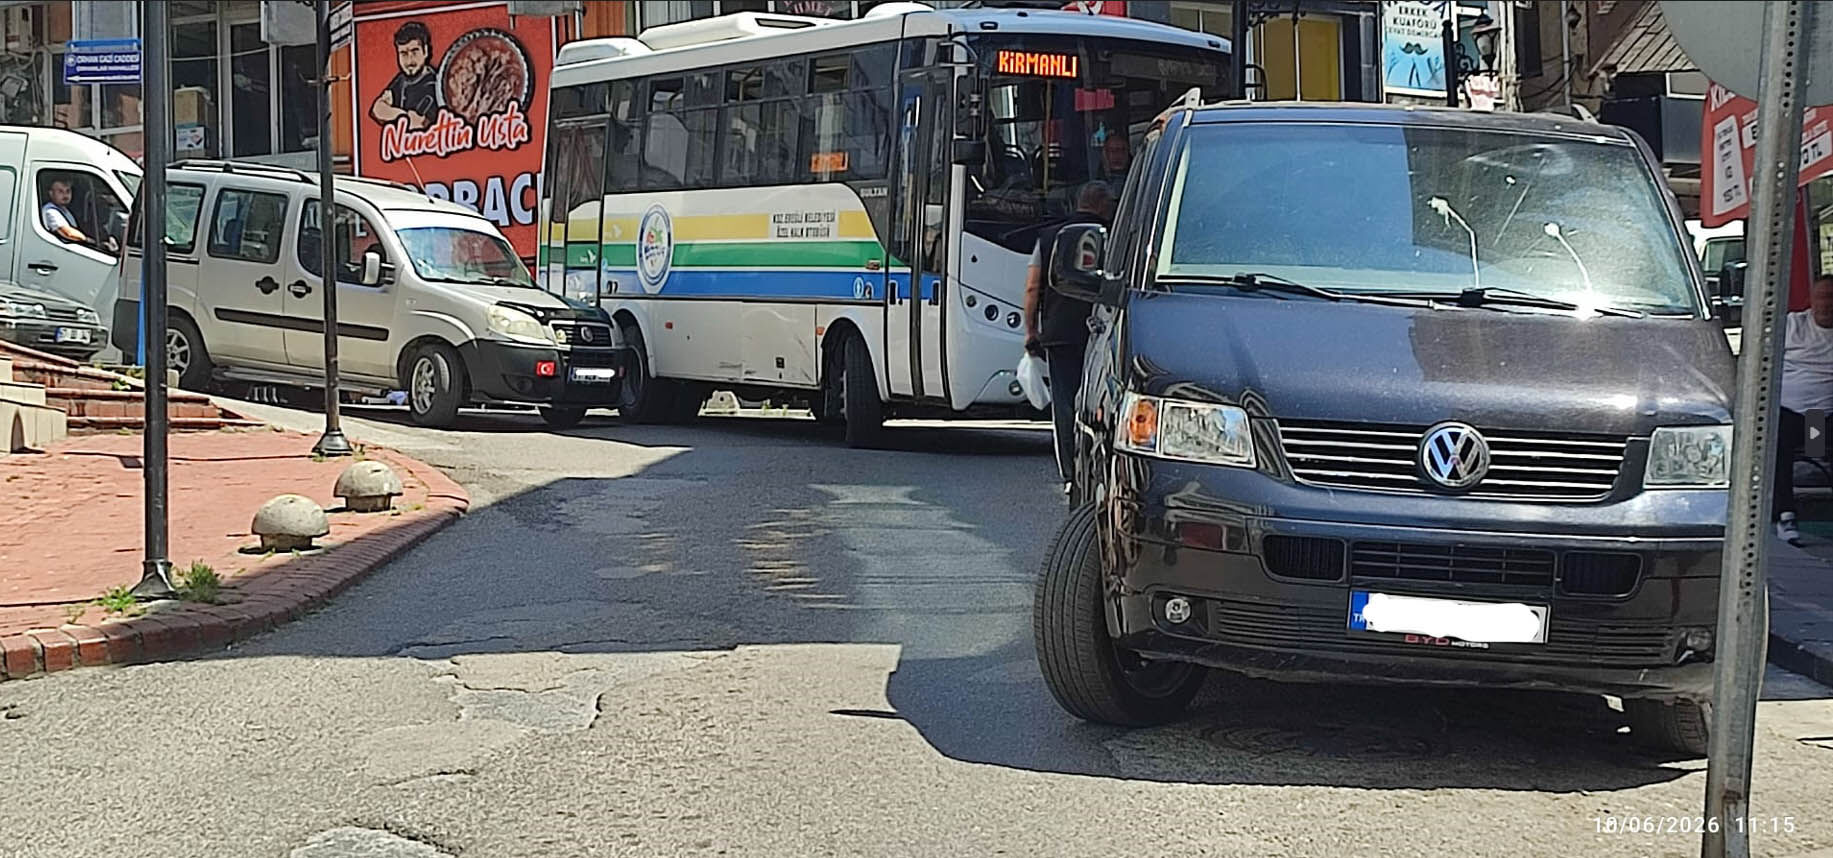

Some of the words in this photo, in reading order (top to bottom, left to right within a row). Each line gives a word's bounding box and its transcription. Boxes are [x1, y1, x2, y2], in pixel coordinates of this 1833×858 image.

[1399, 6, 1427, 15] ERKEK
[382, 109, 474, 161] Nurettin
[477, 100, 528, 150] Usta
[1404, 634, 1450, 646] BYD
[1451, 641, 1490, 650] MOTORS
